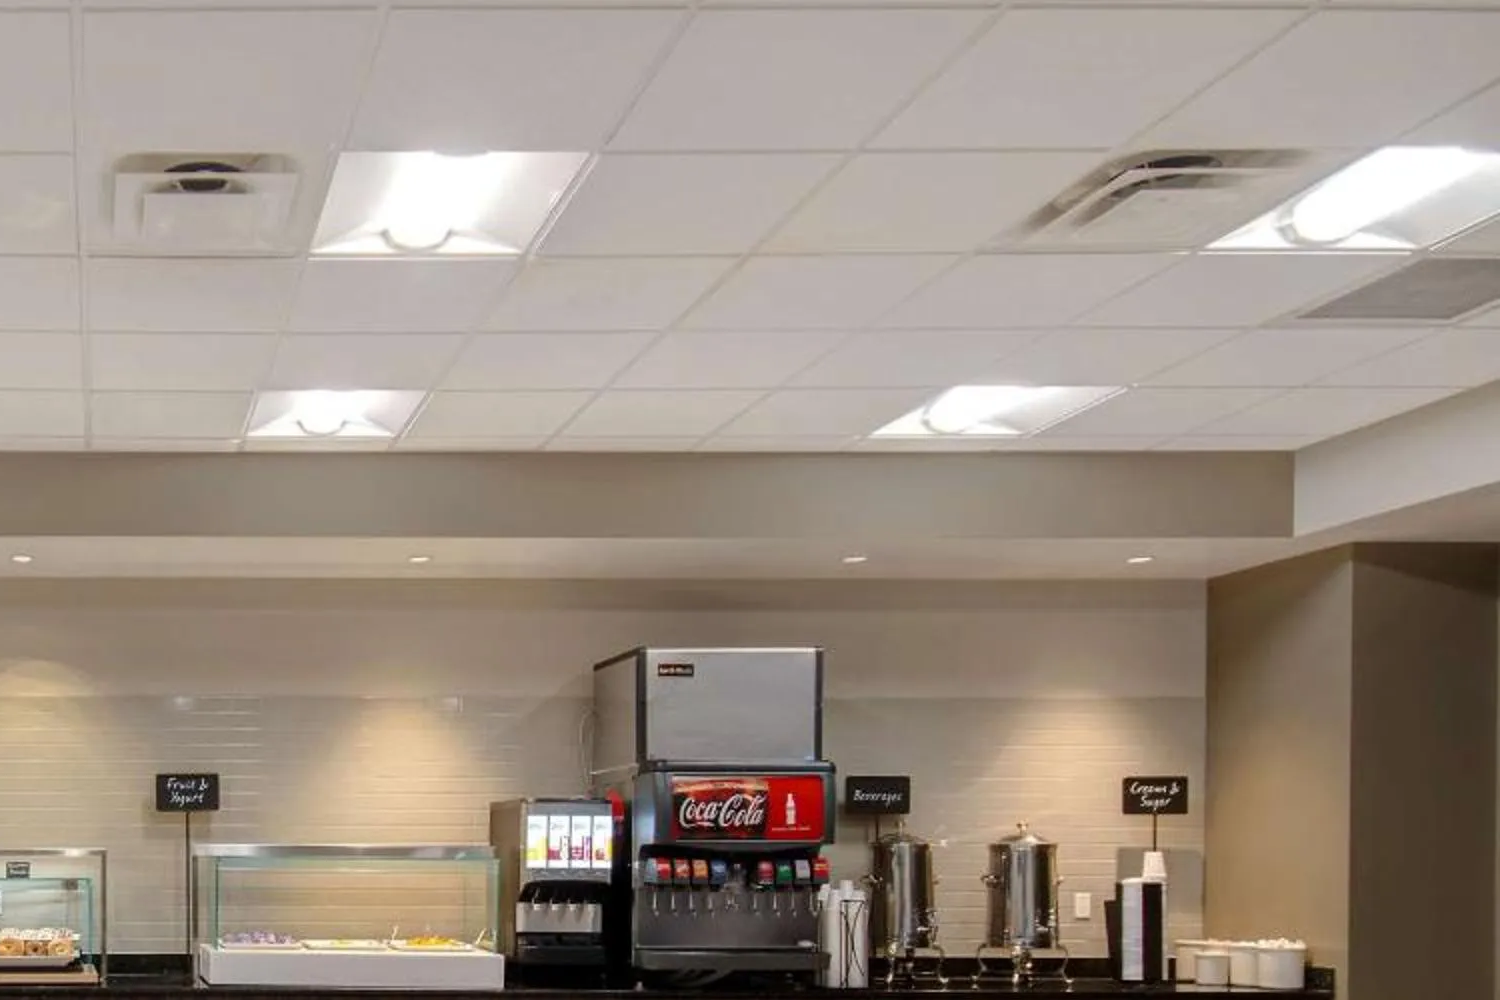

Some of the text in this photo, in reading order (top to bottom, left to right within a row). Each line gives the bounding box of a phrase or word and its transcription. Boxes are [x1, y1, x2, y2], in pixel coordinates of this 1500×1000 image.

[167, 777, 197, 791] Fruit
[853, 788, 904, 809] Beverages
[1140, 793, 1172, 812] Sugar
[679, 793, 767, 829] Coca-Cola
